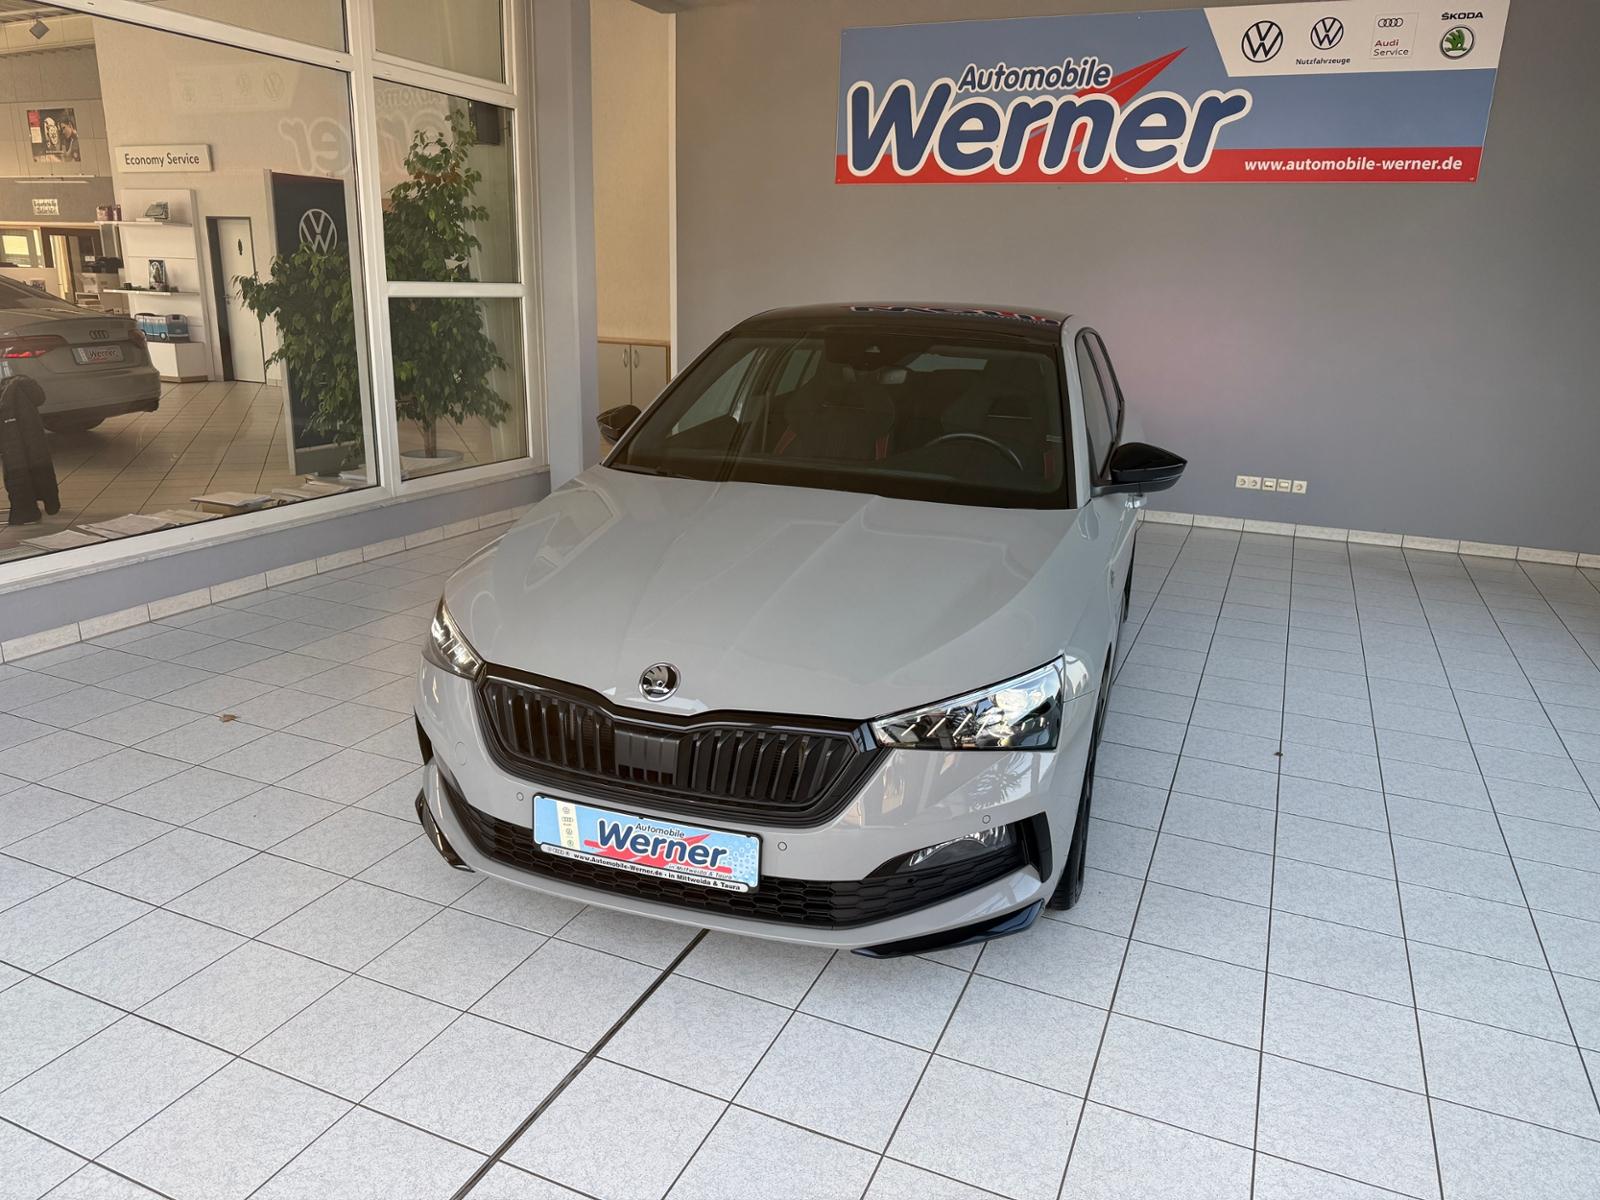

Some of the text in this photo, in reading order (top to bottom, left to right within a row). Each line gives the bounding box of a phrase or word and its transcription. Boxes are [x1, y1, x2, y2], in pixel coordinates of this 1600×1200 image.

[1440, 11, 1484, 21] ŠKODA
[1374, 39, 1400, 48] Audi
[1373, 48, 1409, 57] Service
[1296, 57, 1351, 65] Nutzfahrzeuge
[957, 59, 1111, 91] Automobile
[850, 82, 1249, 174] Werner
[124, 152, 200, 167] Economy Service
[1244, 155, 1463, 171] www.automobile-werner.de
[635, 822, 685, 838] Automobile
[598, 819, 728, 868] Werner
[573, 853, 663, 876] www.Automobile-Werner.de
[676, 873, 710, 885] Mittweida
